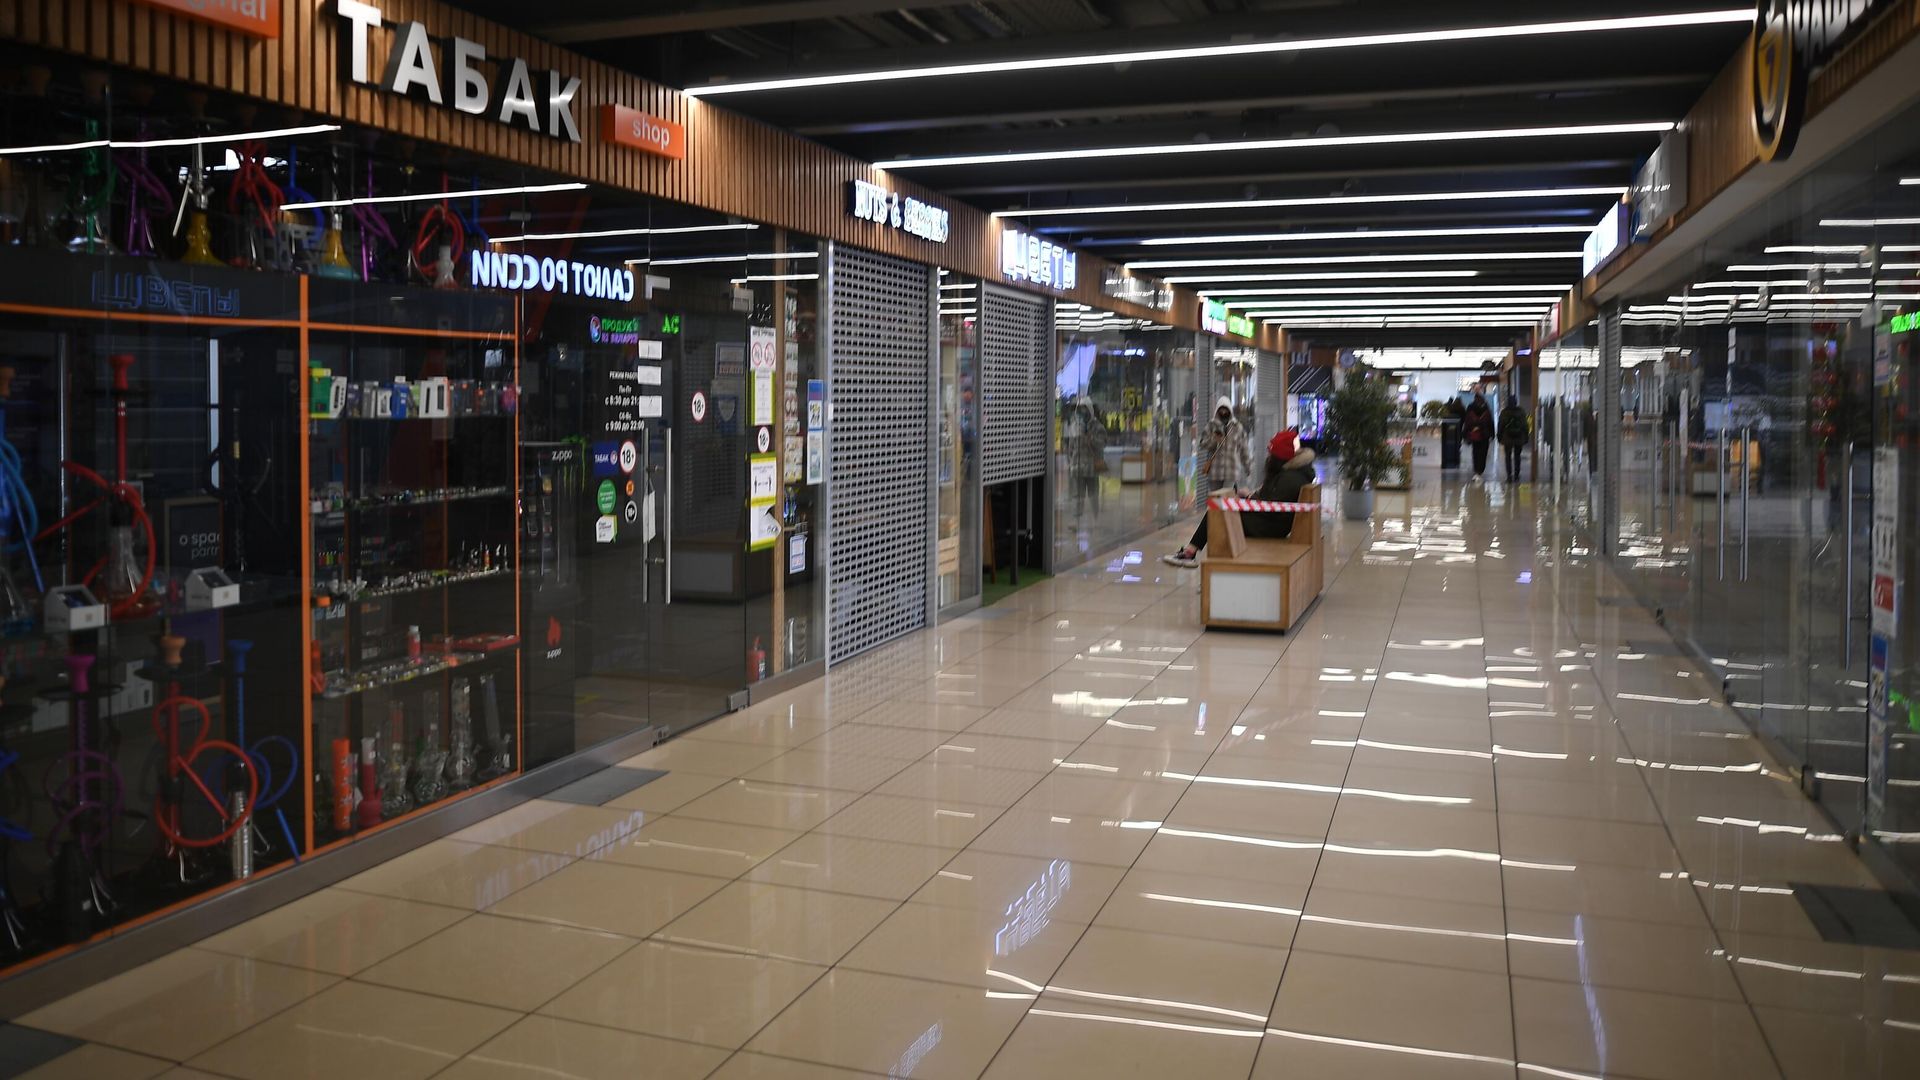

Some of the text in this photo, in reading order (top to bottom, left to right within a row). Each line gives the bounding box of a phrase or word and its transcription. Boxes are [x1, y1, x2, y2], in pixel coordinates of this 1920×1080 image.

[337, 0, 582, 143] ТАБАК
[632, 117, 670, 149] shop
[622, 397, 631, 407] до
[693, 400, 704, 413] 18+
[622, 423, 630, 432] до
[622, 449, 635, 464] 18+
